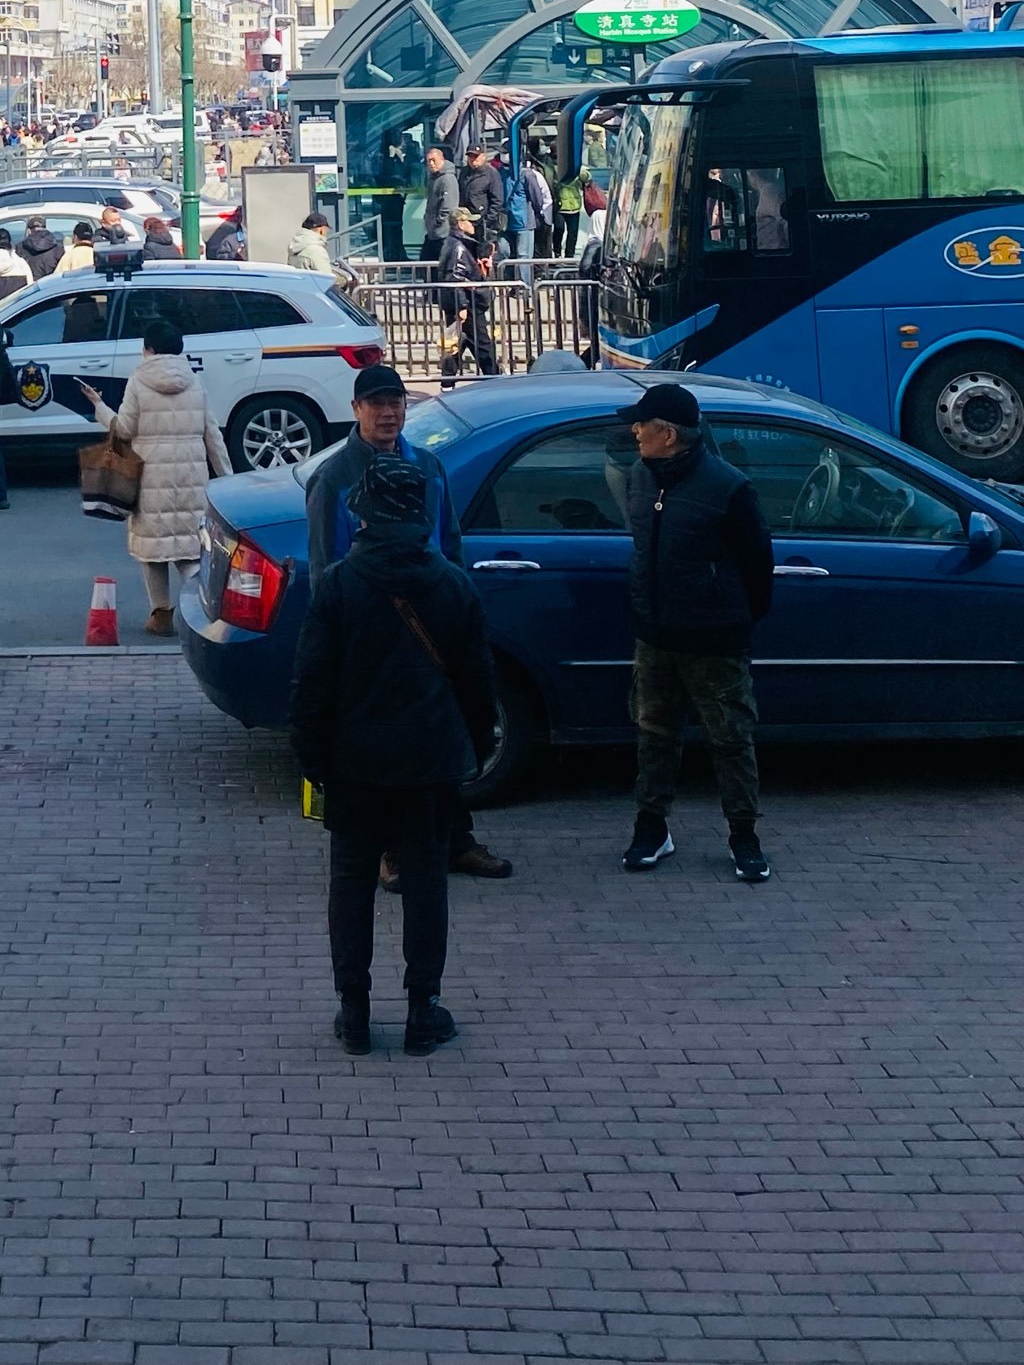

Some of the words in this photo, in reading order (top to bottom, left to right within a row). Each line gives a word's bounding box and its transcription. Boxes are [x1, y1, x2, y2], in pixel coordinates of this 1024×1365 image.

[597, 14, 679, 29] 清真寺站
[653, 27, 678, 35] Station
